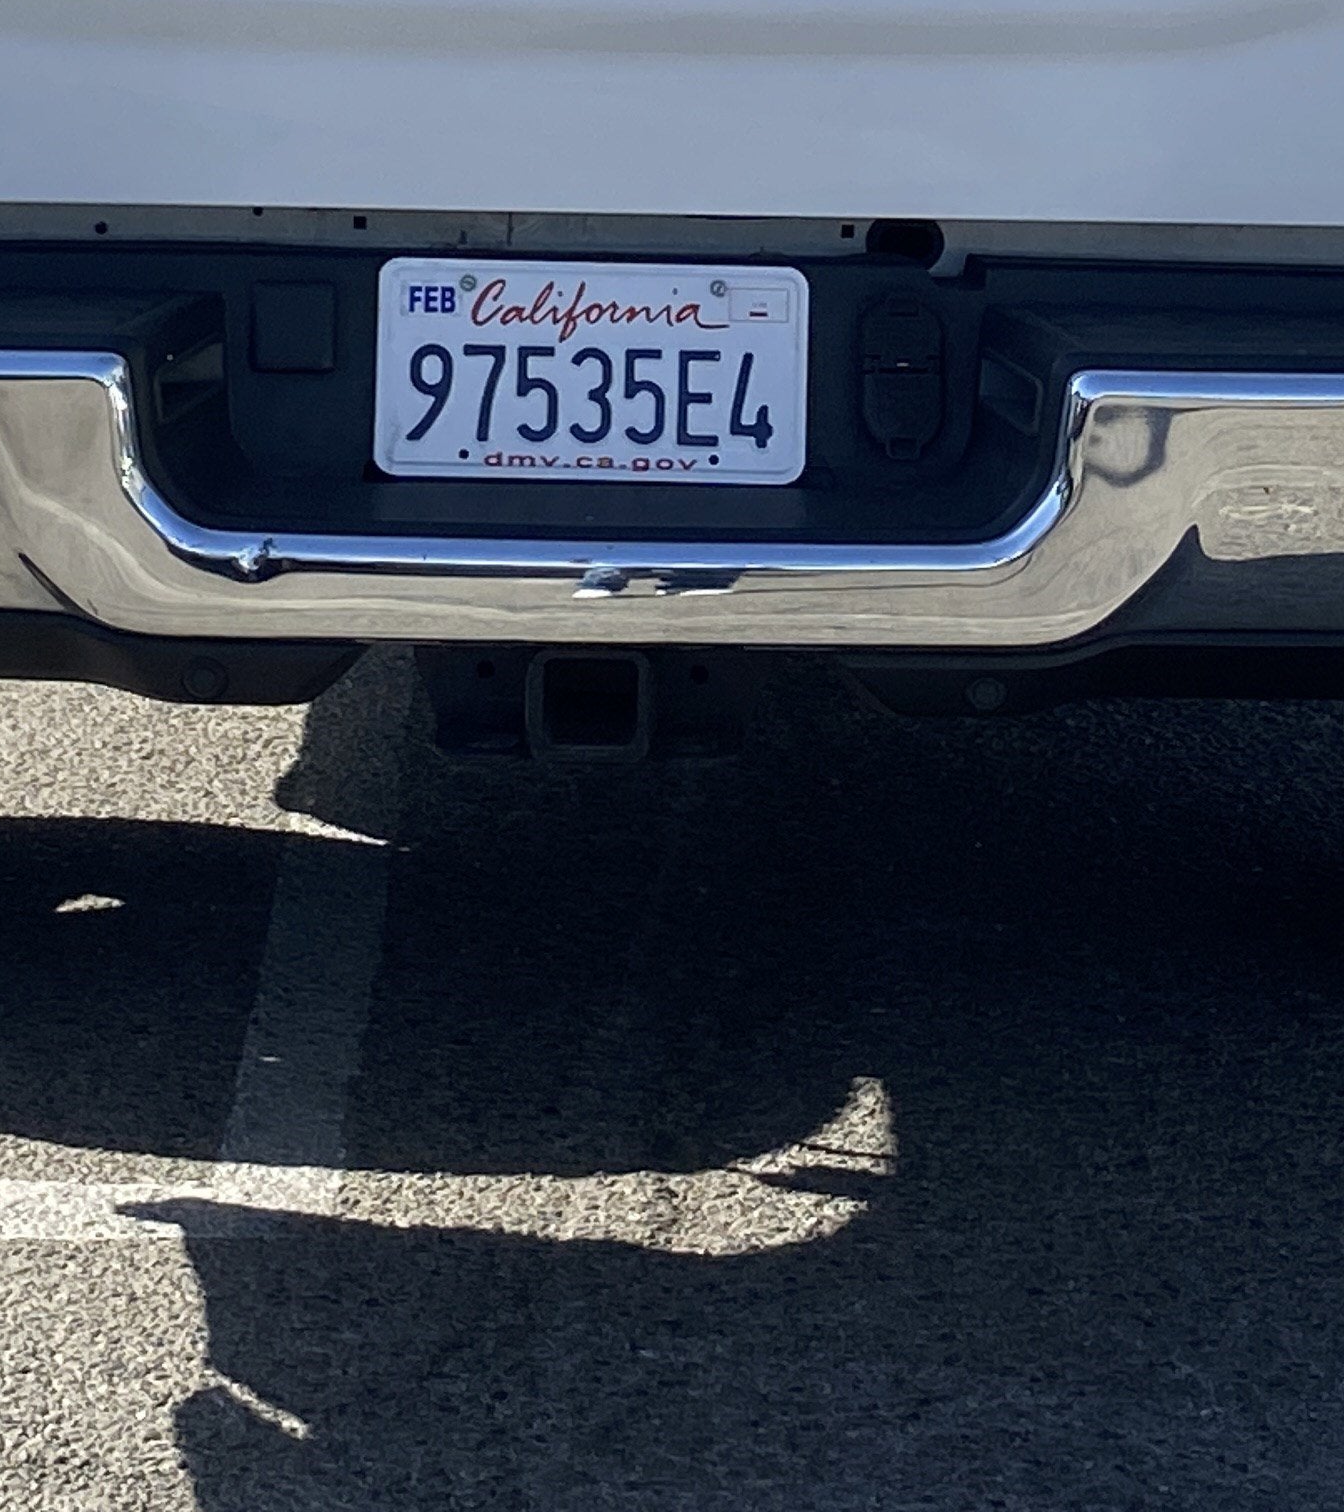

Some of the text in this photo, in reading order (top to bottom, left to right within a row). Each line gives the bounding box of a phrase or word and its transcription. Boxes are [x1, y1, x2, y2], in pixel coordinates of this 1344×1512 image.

[408, 285, 456, 313] FEB
[471, 279, 730, 343] California
[406, 343, 774, 449] 97535E4
[484, 451, 698, 472] dmv.ca.gov
